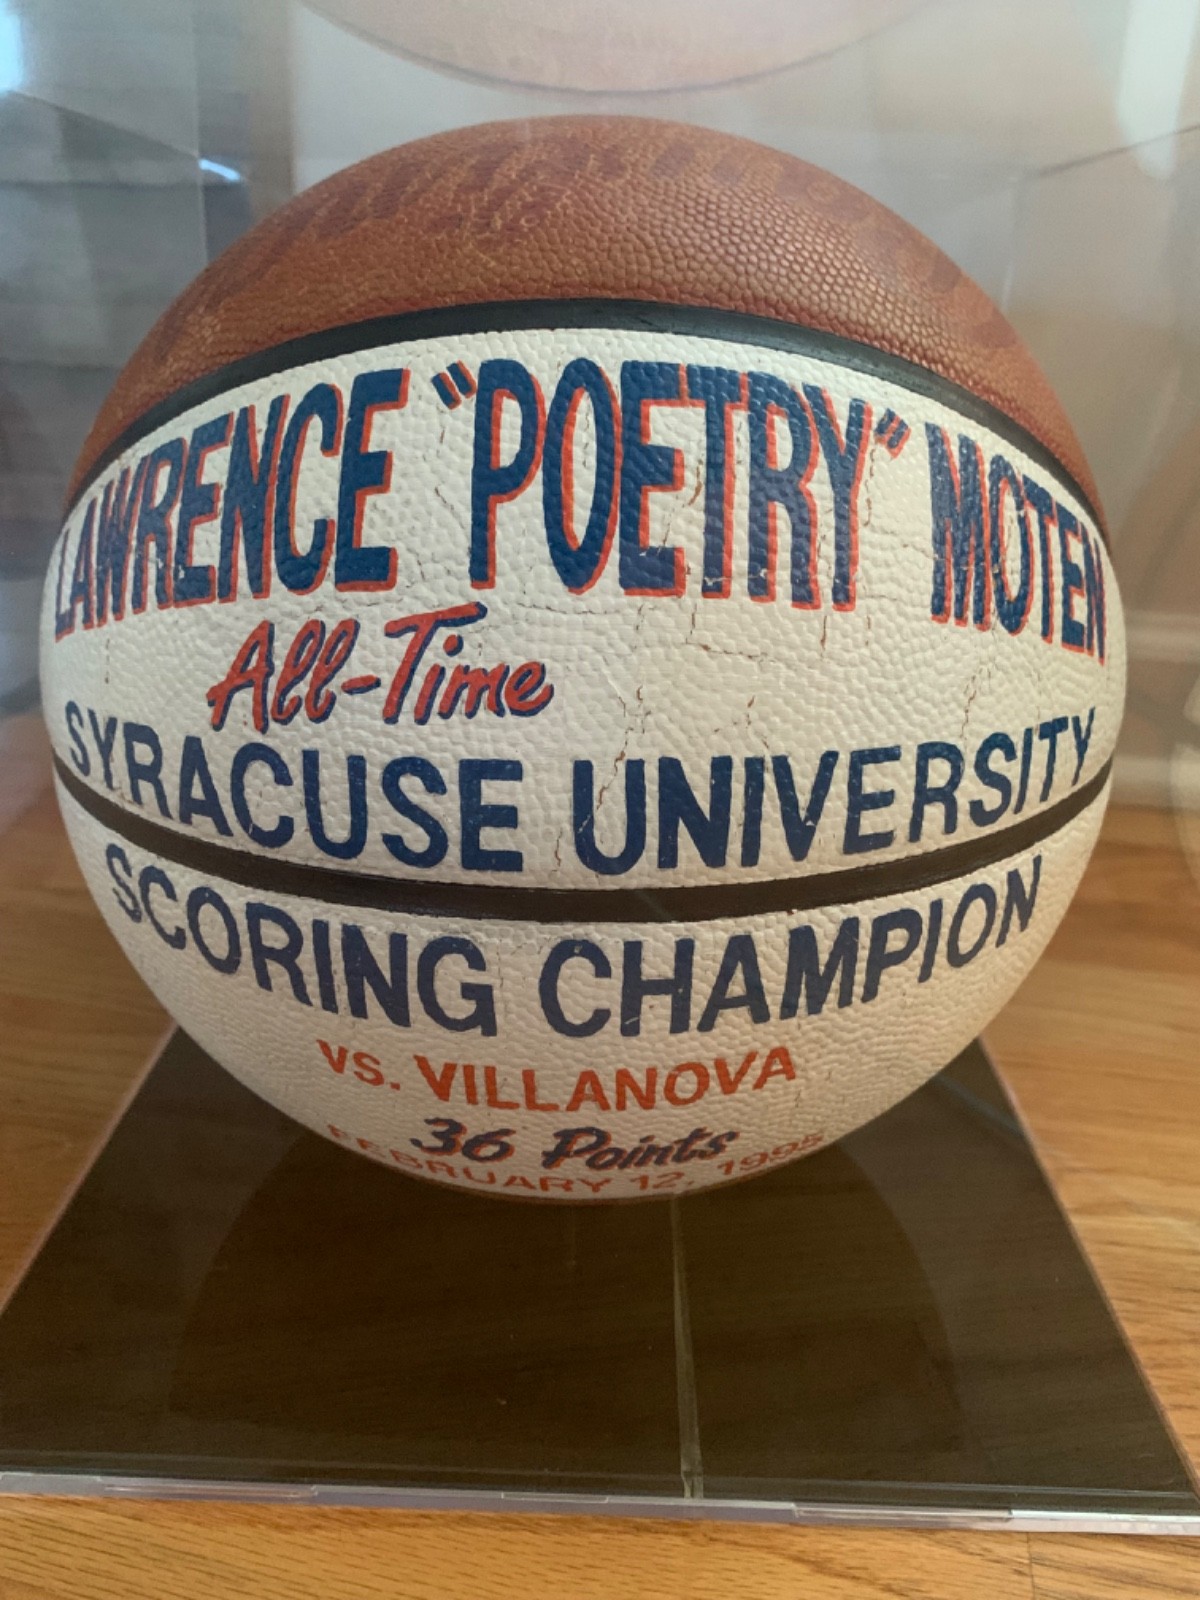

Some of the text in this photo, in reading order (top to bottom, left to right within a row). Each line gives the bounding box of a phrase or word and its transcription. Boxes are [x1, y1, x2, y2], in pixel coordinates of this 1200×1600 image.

[55, 357, 1106, 666] LAWRENCE "POETRY" MOTEN
[207, 601, 554, 733] All-Time
[65, 701, 1096, 876] SYRACUSE UNIVERSITY
[106, 843, 1042, 1038] SCORING CHAMPION
[316, 1039, 796, 1112] VS. VILLANOVA
[409, 1117, 740, 1170] 36 Points
